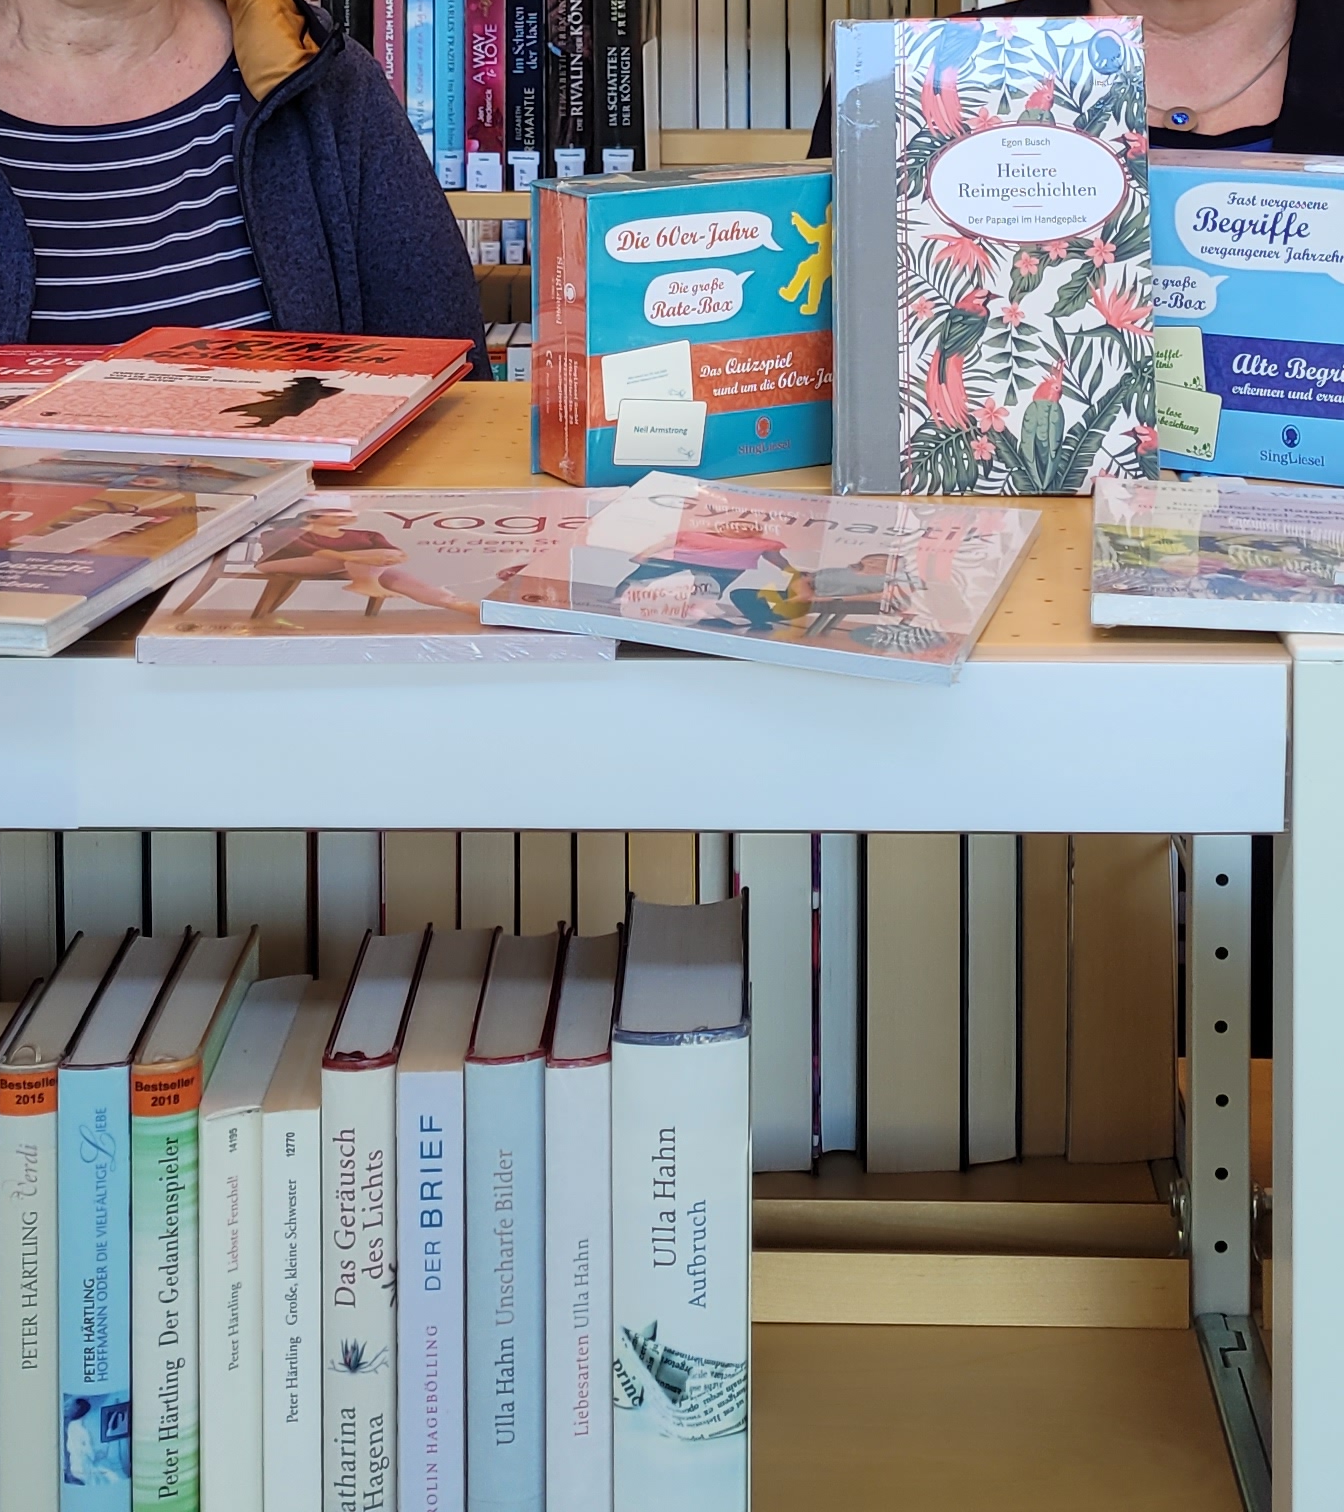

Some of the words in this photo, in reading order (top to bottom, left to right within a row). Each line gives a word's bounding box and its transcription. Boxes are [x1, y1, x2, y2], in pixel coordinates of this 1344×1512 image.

[386, 19, 394, 40] ZUM
[486, 24, 498, 64] LOVE
[473, 32, 486, 69] WAY
[571, 54, 584, 117] RIVALIN
[607, 46, 618, 112] SCHATTEN
[619, 47, 631, 104] KÖNIGIN
[1001, 137, 1024, 149] Egon
[1027, 135, 1050, 147] Busch
[997, 162, 1058, 179] Heitere
[958, 180, 1097, 203] Reimgeschichten
[1227, 193, 1256, 208] Fast
[1260, 196, 1329, 212] vergessene
[617, 229, 650, 252] Die
[655, 221, 760, 253] 60er-Jahre
[968, 215, 983, 225] Der
[986, 215, 1017, 227] Papagei
[1034, 213, 1087, 226] Handgepäck
[1193, 208, 1311, 245] Begriffe
[1200, 245, 1280, 263] vergangener
[668, 281, 688, 296] Die
[691, 278, 724, 297] große
[1163, 275, 1197, 290] große
[650, 296, 734, 320] Rate-Box
[700, 363, 722, 378] Das
[725, 352, 793, 382] Quizspiel
[1232, 353, 1279, 376] Alte
[713, 382, 738, 396] rund
[741, 382, 758, 394] um
[760, 377, 776, 391] die
[1231, 383, 1284, 399] erkennen
[1287, 389, 1312, 402] und
[633, 424, 653, 436] Neil
[656, 425, 688, 438] Armstrong
[738, 438, 792, 455] SingLiesel
[1260, 450, 1325, 468] SingLiesel
[418, 1114, 444, 1228] BRIEF
[652, 1126, 677, 1206] Hahn
[333, 1128, 357, 1253] Geräusch
[361, 1149, 385, 1237] Lichts
[157, 1136, 186, 1303] Gedankenspieler
[653, 1212, 677, 1270] Ulla
[685, 1200, 707, 1310] Aufbruch
[362, 1240, 385, 1282] des
[423, 1239, 442, 1292] DER
[333, 1257, 357, 1309] Das
[157, 1308, 179, 1347] Der
[157, 1358, 186, 1429] Härtling
[158, 1433, 179, 1501] Peter
